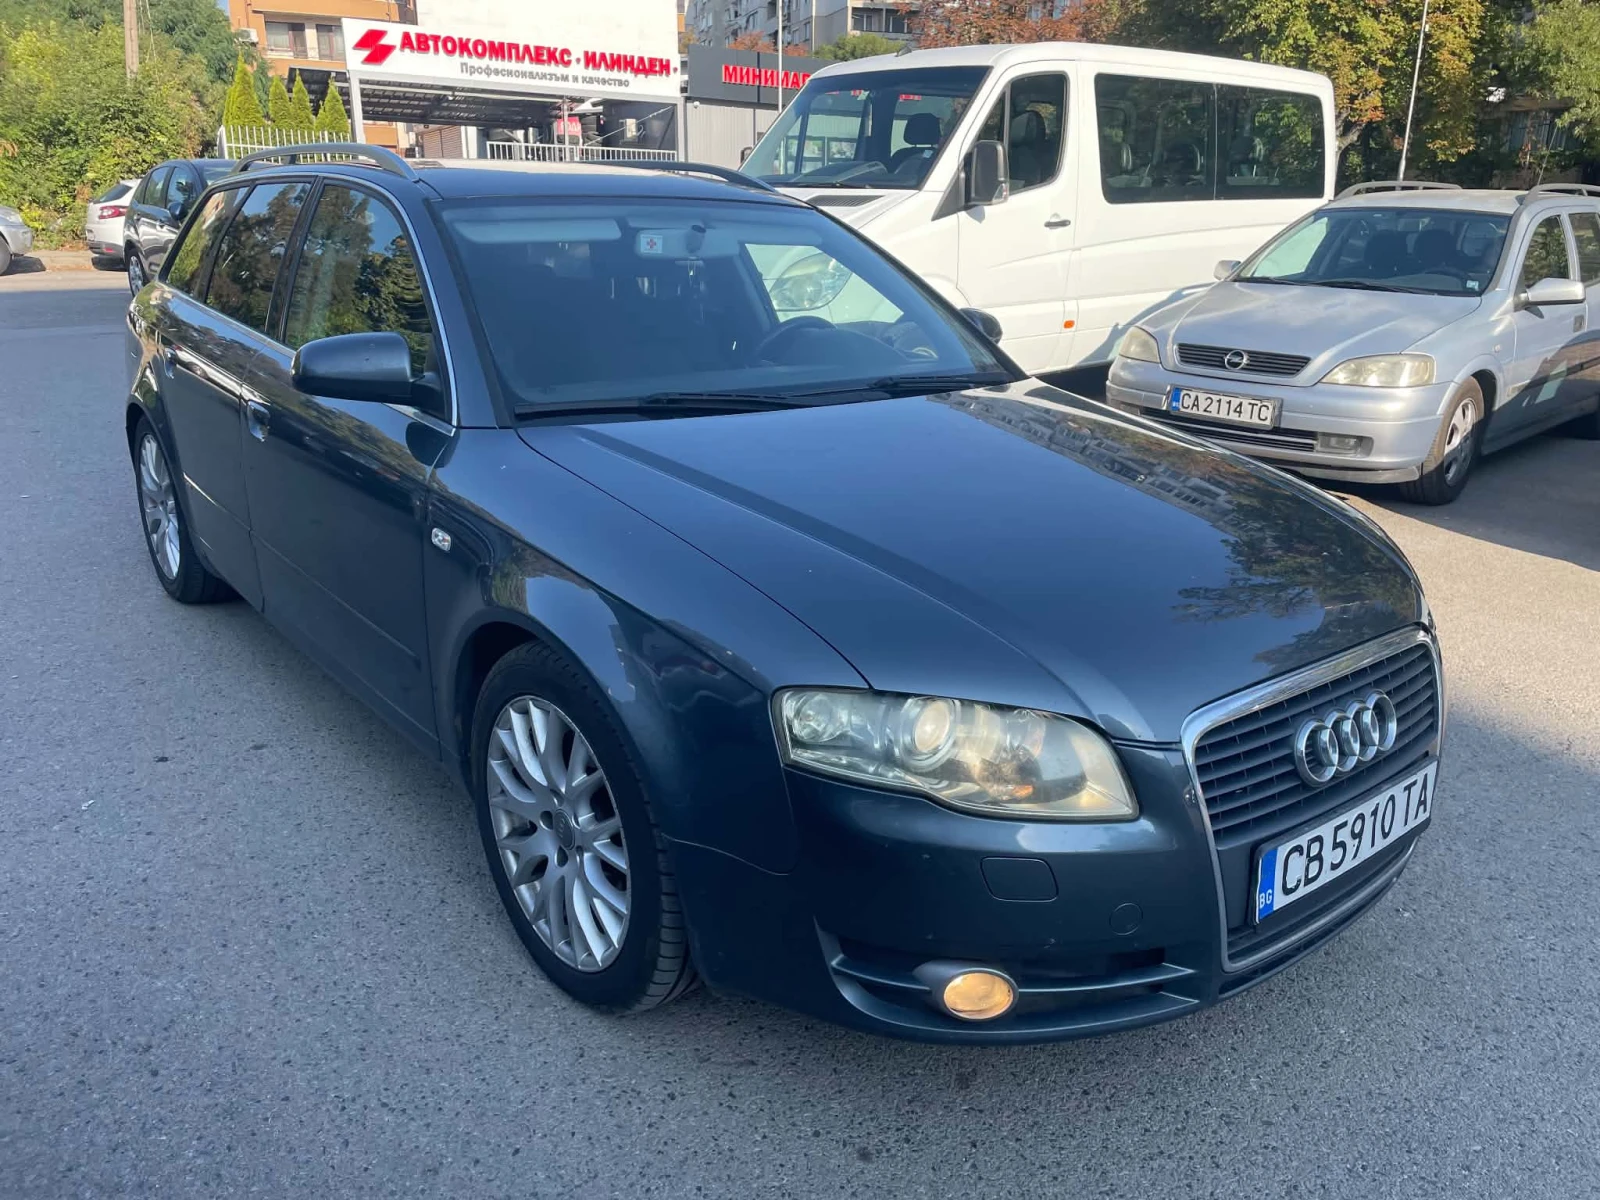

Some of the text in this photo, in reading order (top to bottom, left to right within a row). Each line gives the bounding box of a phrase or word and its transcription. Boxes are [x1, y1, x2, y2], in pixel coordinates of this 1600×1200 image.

[400, 31, 671, 78] АВТОКОМПЛЕКС ИЛИНДЕН
[460, 62, 630, 87] Професионализъм и качество
[1203, 396, 1243, 418] 2114
[1330, 794, 1396, 872] 5910
[1259, 889, 1272, 908] BG
